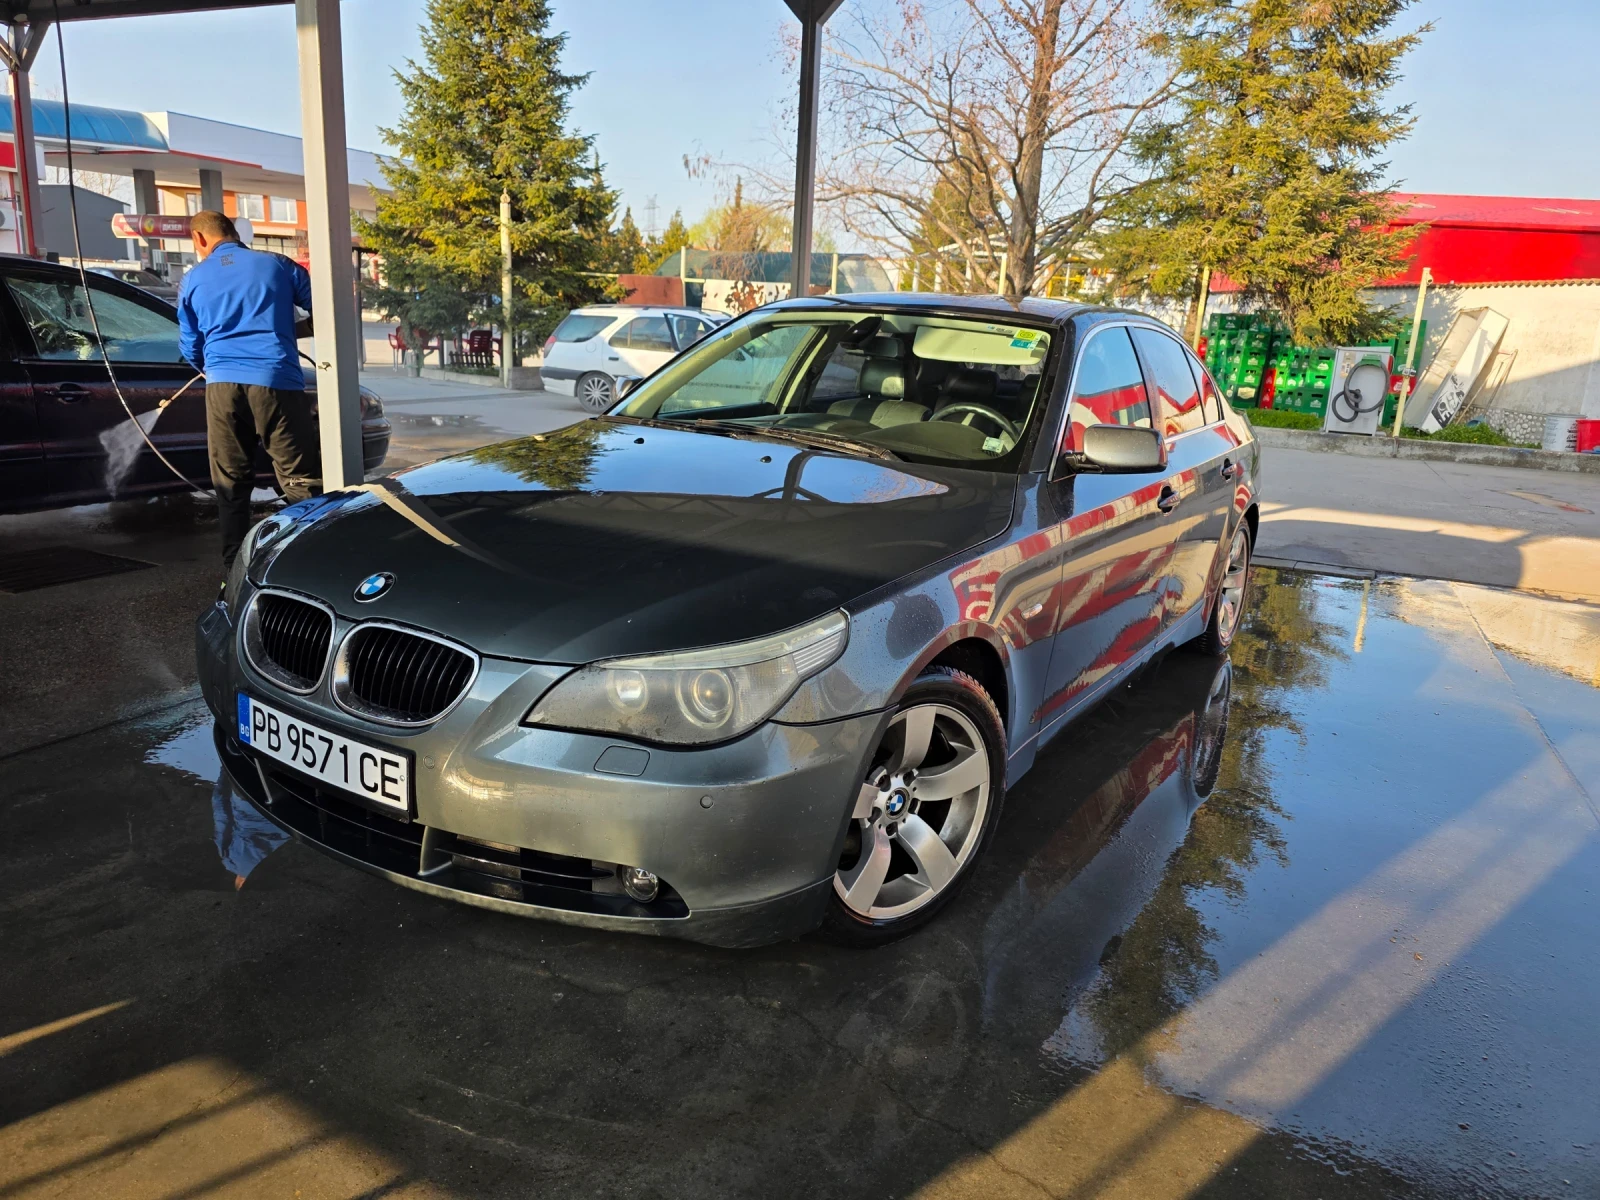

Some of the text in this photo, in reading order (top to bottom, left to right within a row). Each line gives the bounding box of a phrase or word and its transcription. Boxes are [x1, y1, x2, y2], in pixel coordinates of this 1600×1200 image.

[240, 722, 250, 737] BG
[252, 705, 402, 803] PB 9571 CE
